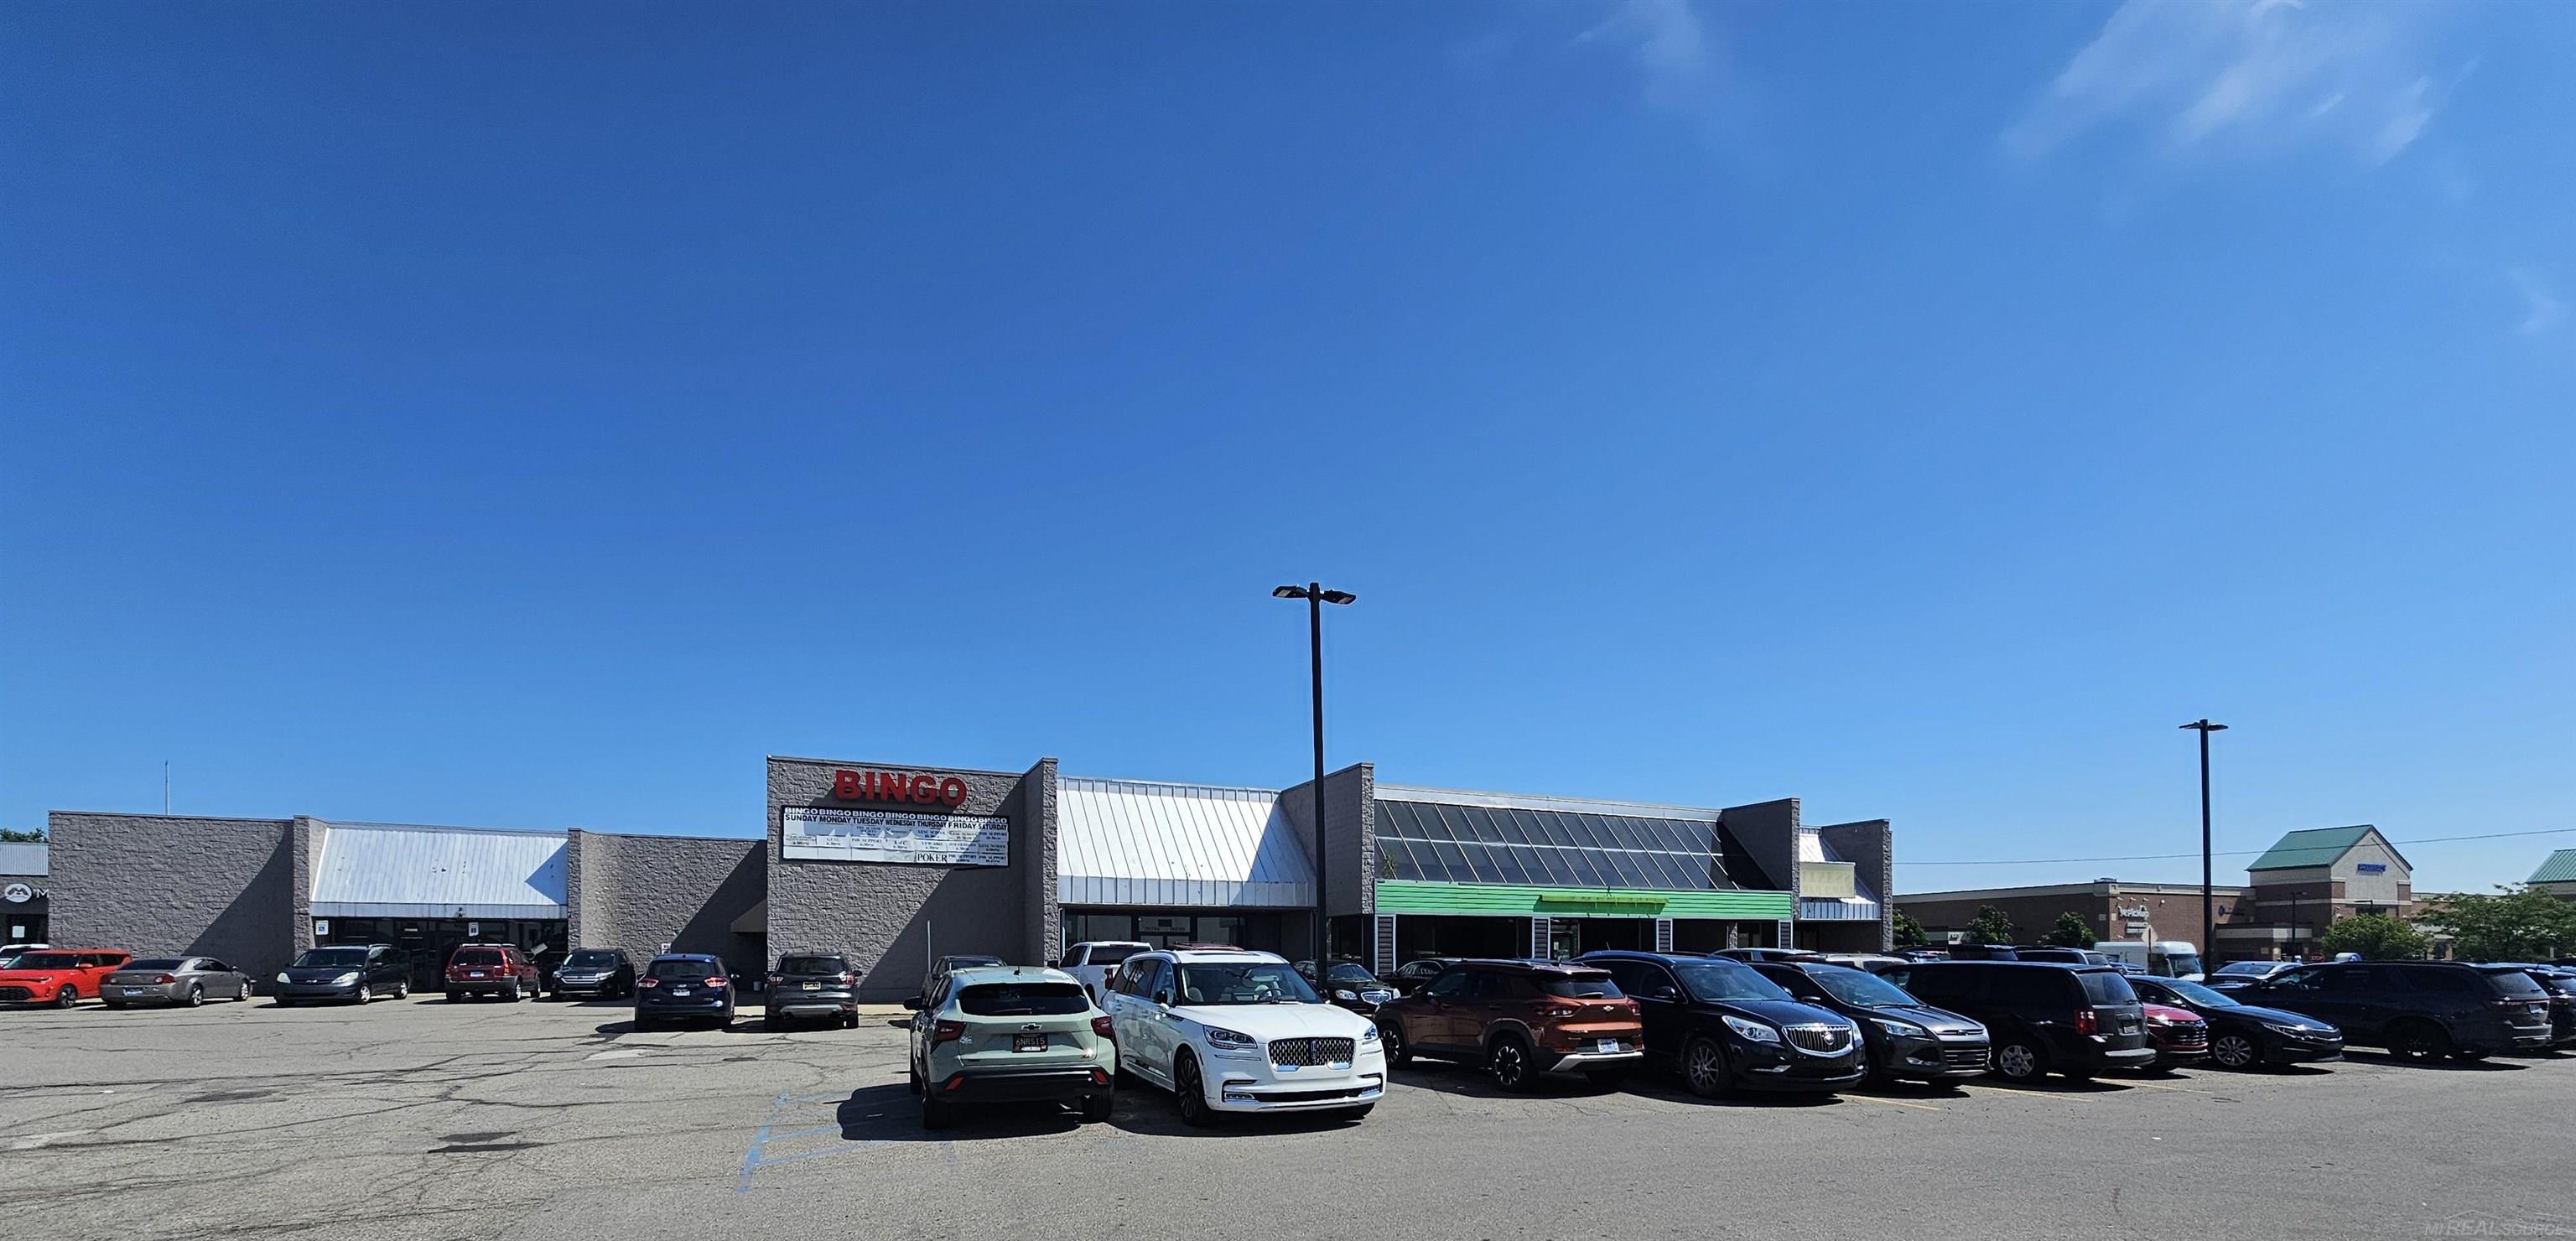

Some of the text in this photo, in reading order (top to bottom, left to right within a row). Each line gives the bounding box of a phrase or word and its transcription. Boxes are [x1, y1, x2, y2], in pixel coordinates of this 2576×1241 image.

[835, 770, 967, 806] BINGO
[785, 813, 818, 822] SUNDAY
[819, 815, 851, 823] MONDAY
[853, 817, 884, 825] TUESDAY
[917, 853, 948, 863] POKER
